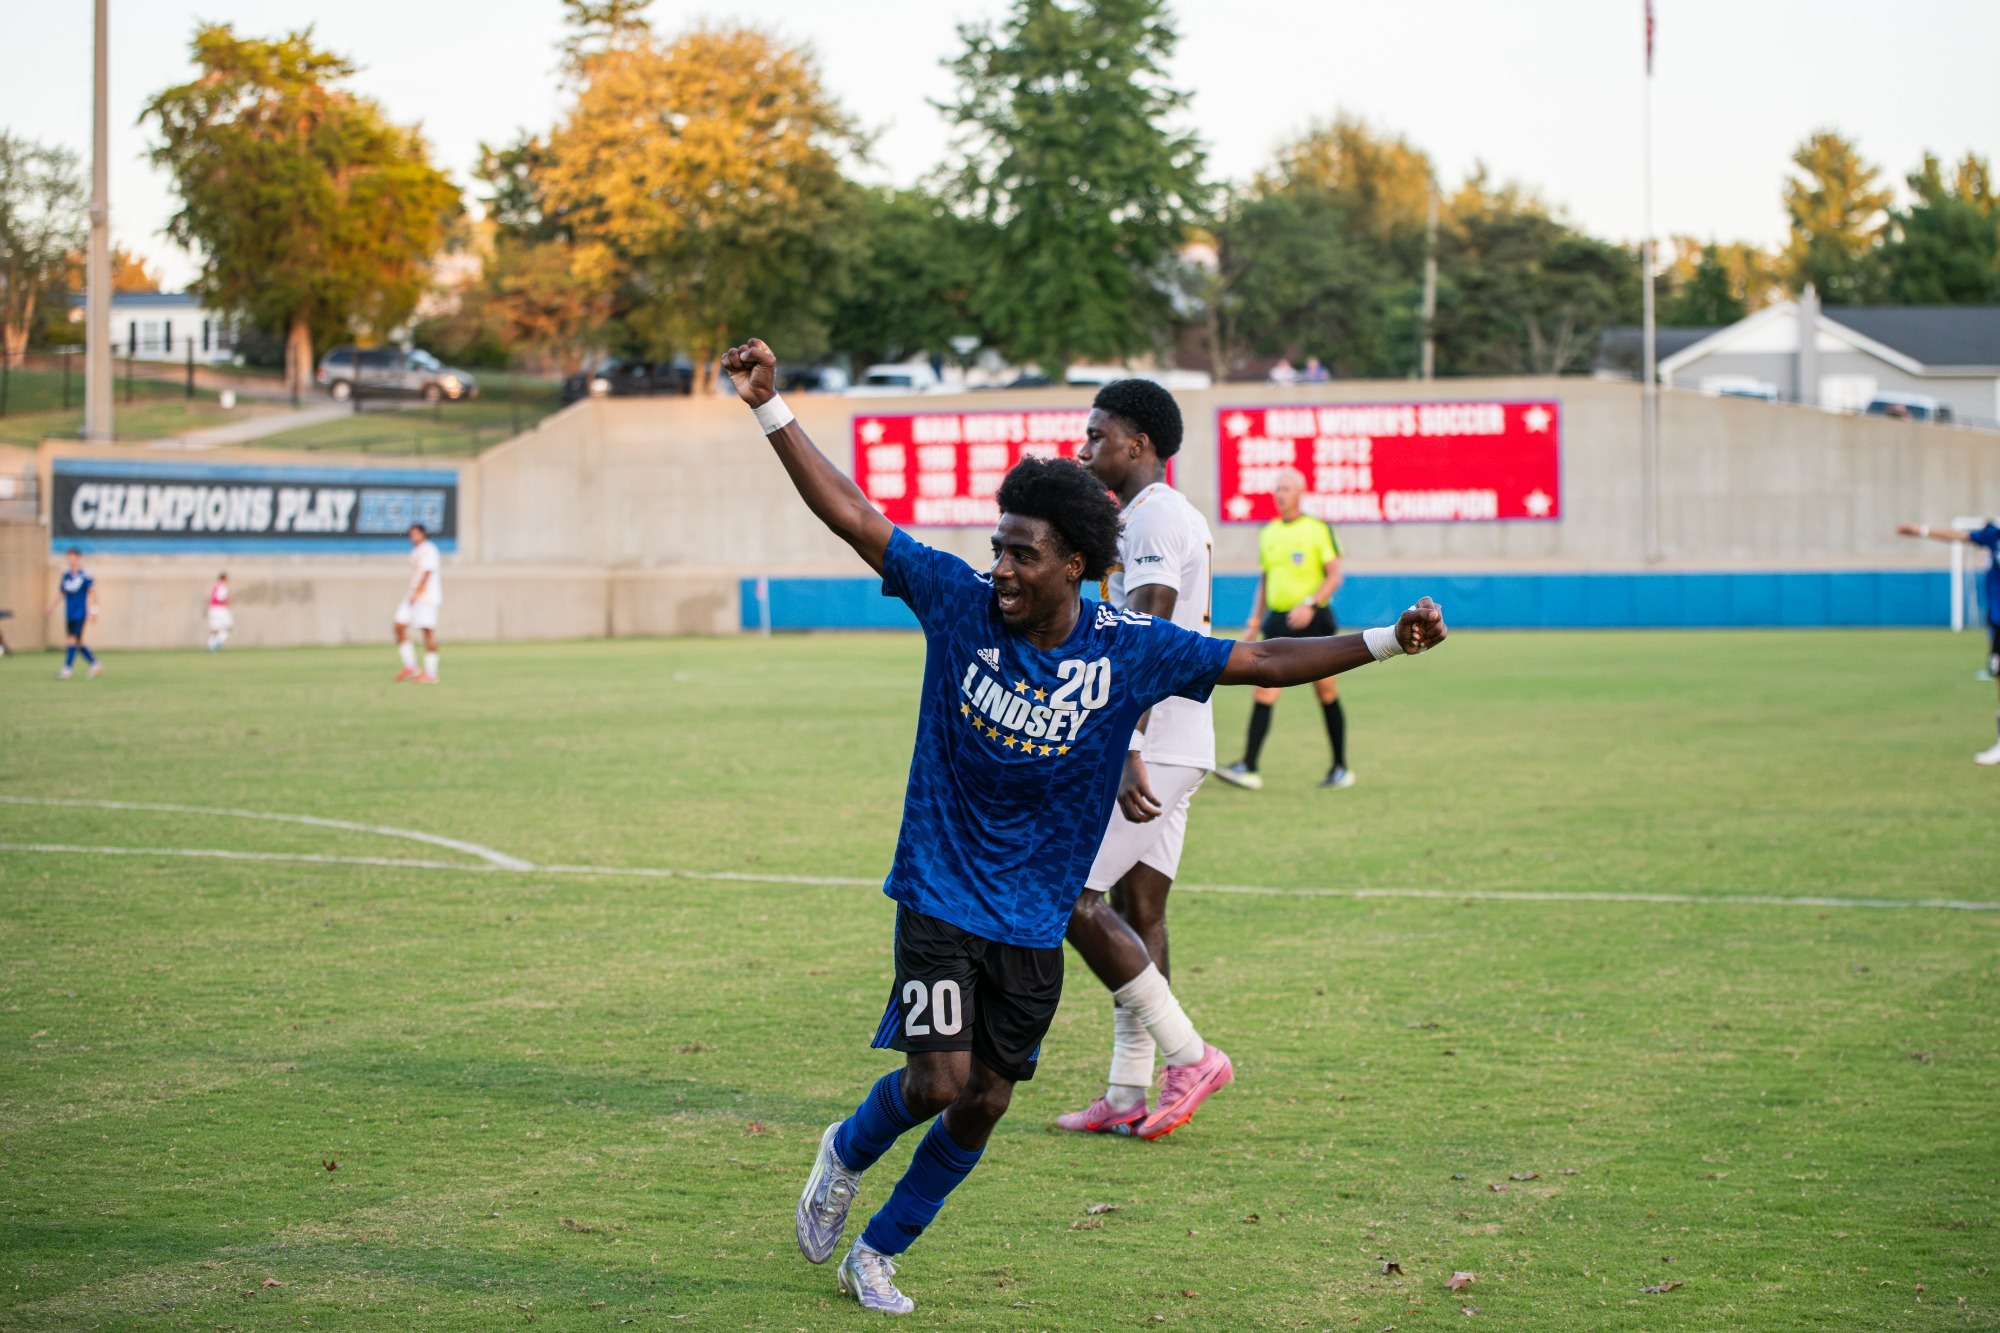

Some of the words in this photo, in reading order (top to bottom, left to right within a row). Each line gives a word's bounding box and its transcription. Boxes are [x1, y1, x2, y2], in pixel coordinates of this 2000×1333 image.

[1027, 412, 1090, 441] SOCC
[1418, 404, 1506, 436] SOCCER
[71, 483, 273, 532] CHAMPIONS
[275, 487, 356, 532] PLAY
[1300, 490, 1381, 521] ATIONAL
[1383, 488, 1498, 520] CHAMPION
[1144, 555, 1164, 563] TECH
[977, 649, 1000, 672] adidas
[1050, 657, 1111, 710] 20
[961, 662, 1091, 742] LINDSEY
[902, 979, 963, 1037] 20
